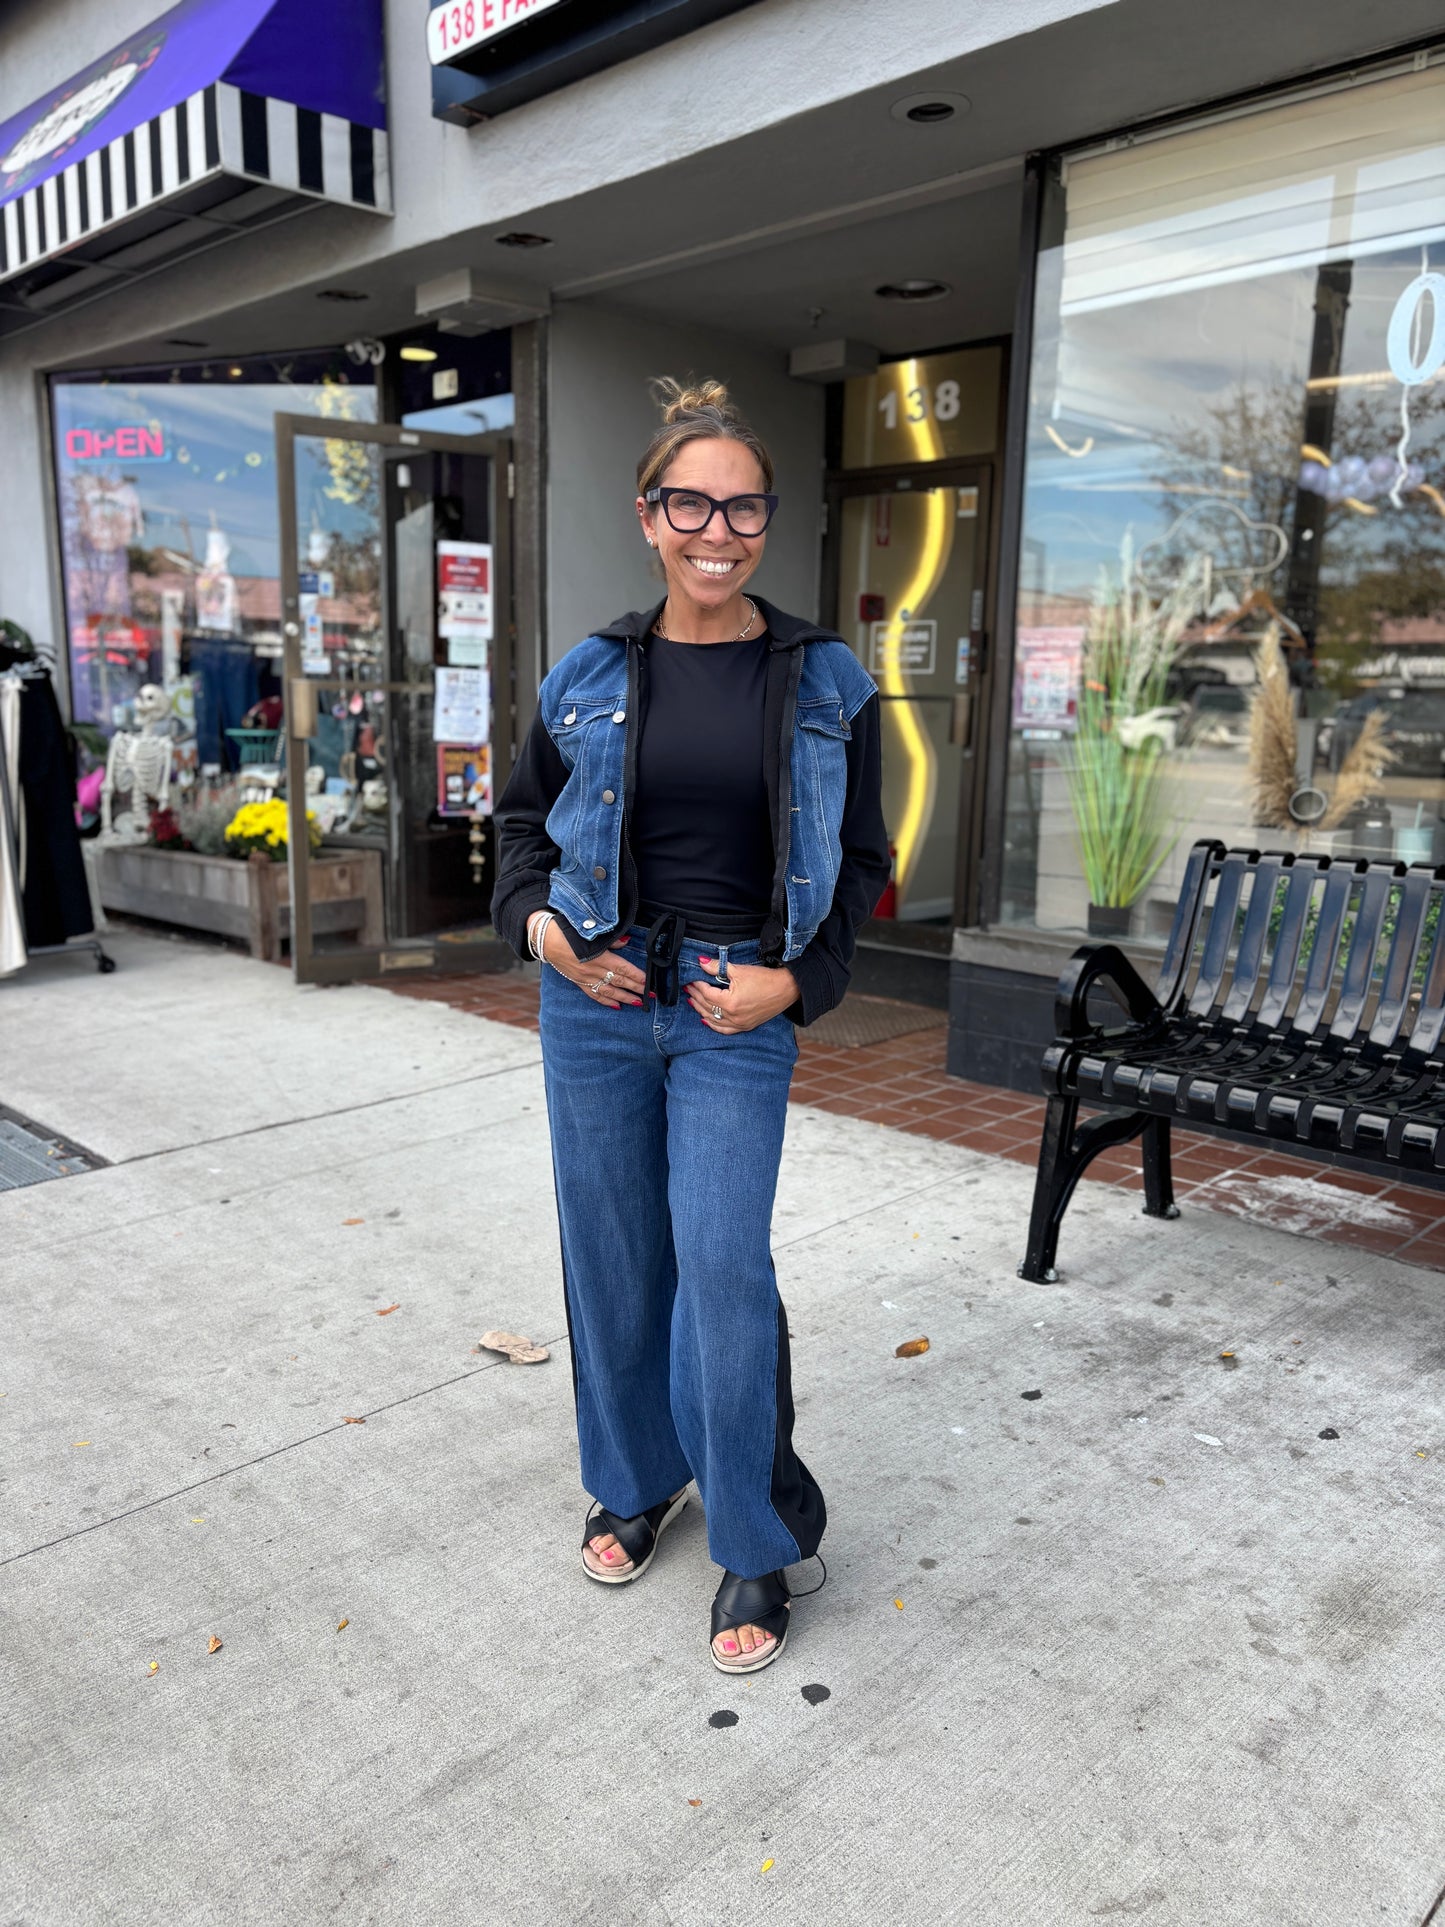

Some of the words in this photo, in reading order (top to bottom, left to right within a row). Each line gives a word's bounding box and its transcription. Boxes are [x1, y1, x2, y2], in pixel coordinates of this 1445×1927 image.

[438, 0, 475, 50] 138
[482, 0, 494, 31] E
[879, 379, 961, 430] 138
[66, 427, 164, 459] OPEN
